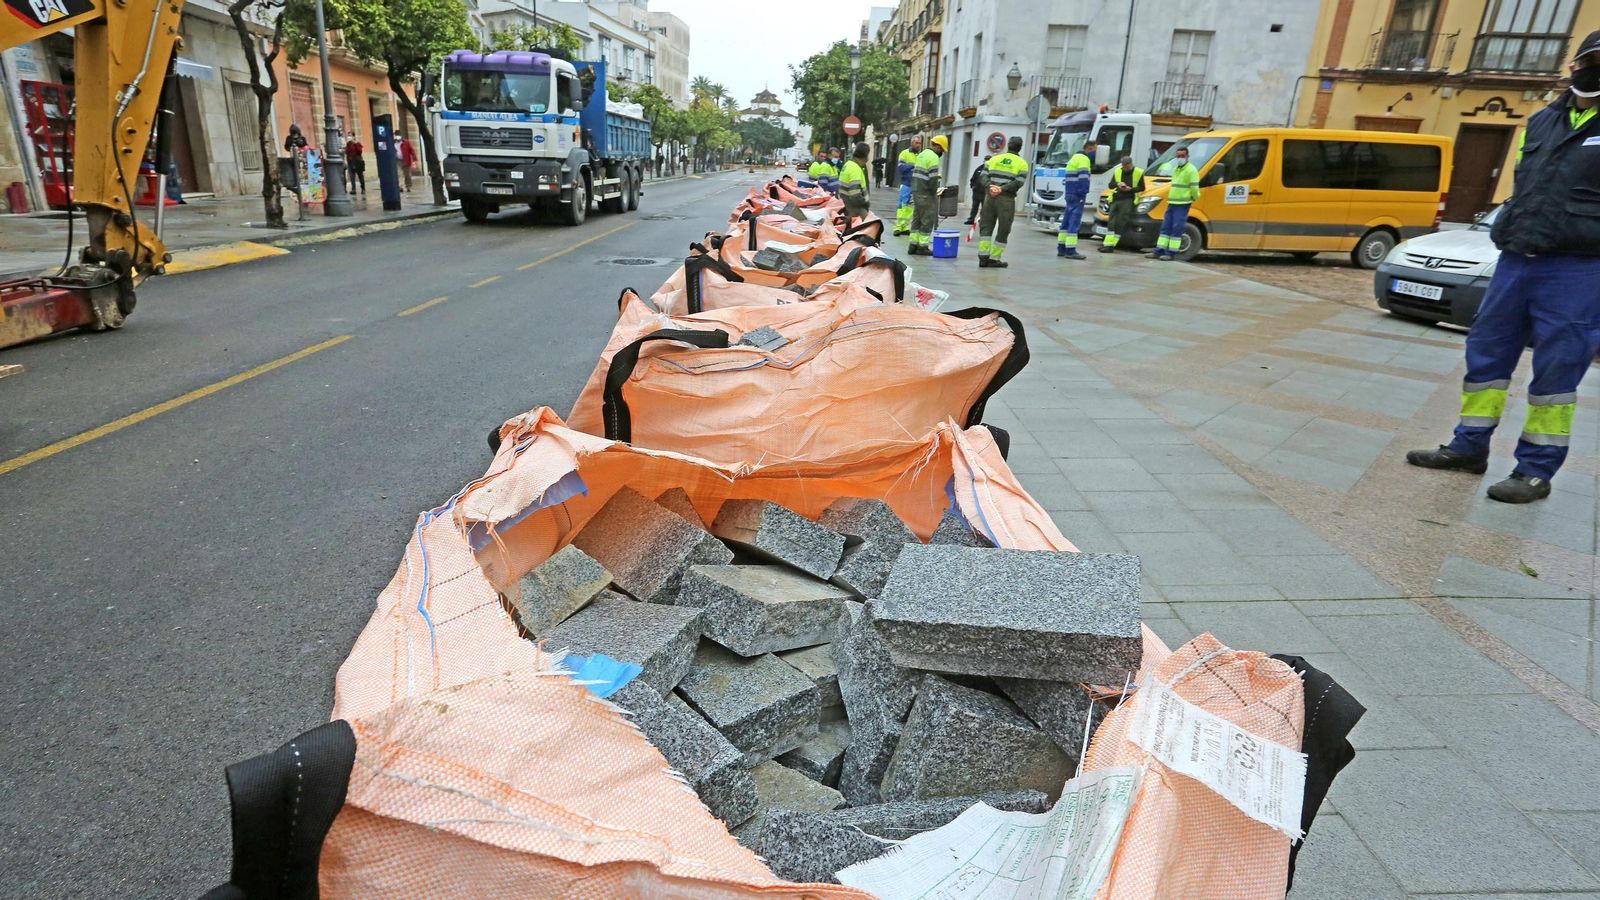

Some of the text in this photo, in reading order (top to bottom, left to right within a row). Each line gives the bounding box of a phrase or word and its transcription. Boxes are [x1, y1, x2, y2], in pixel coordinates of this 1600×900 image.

[378, 126, 385, 135] P
[1421, 286, 1439, 298] CGT
[1155, 704, 1168, 740] PACKAGING
[1056, 793, 1077, 849] INSPECTION
